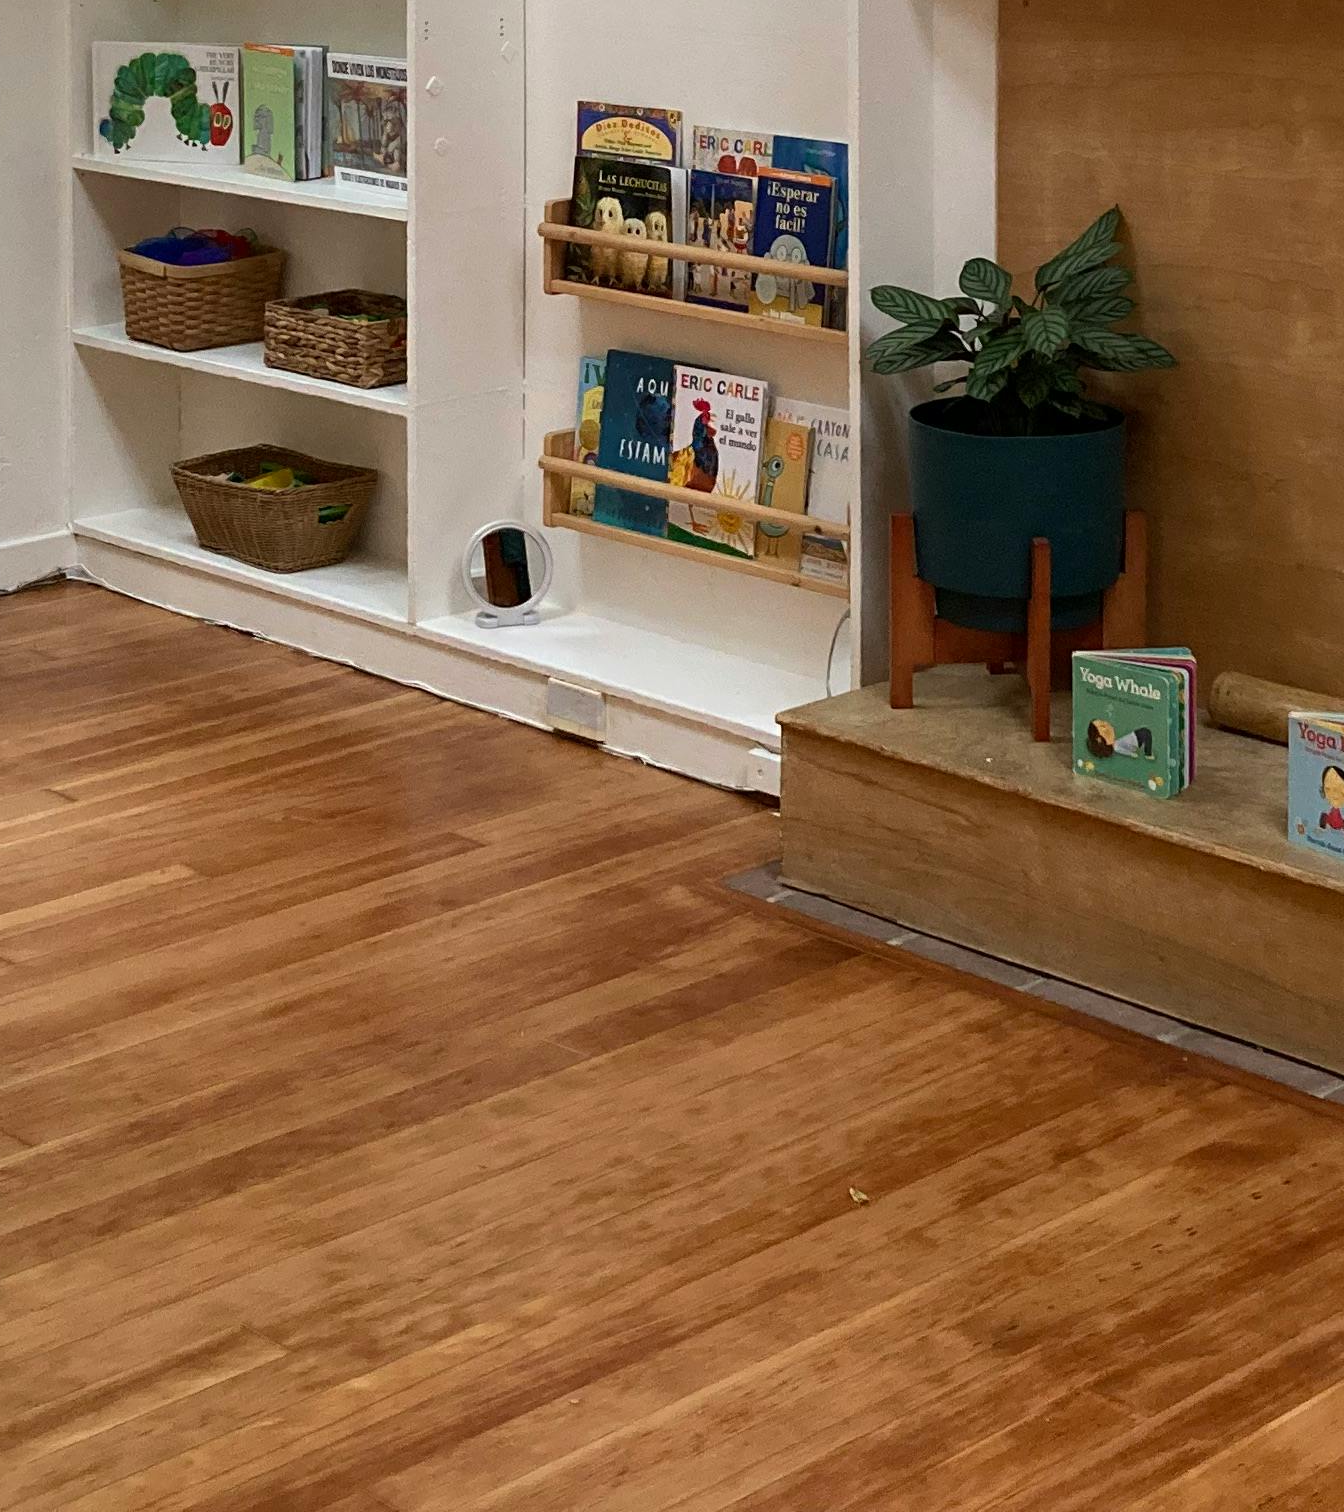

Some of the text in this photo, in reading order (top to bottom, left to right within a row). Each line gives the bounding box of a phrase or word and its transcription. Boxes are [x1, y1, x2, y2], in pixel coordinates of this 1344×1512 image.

[621, 119, 660, 140] Deditos
[699, 134, 729, 152] ERIC
[598, 169, 617, 185] LAS
[619, 175, 668, 193] LECHUCITAS
[767, 180, 820, 204] ¡Esperar
[775, 202, 808, 218] no es
[681, 373, 760, 402] ERIC CARLE
[725, 408, 755, 425] El gallo
[720, 423, 736, 434] sale
[745, 429, 758, 439] ver
[618, 438, 666, 466] ESTAM
[718, 435, 757, 451] el mundo
[1079, 666, 1113, 690] Yoga
[1114, 675, 1162, 700] Whale
[1297, 721, 1337, 750] Yoga
